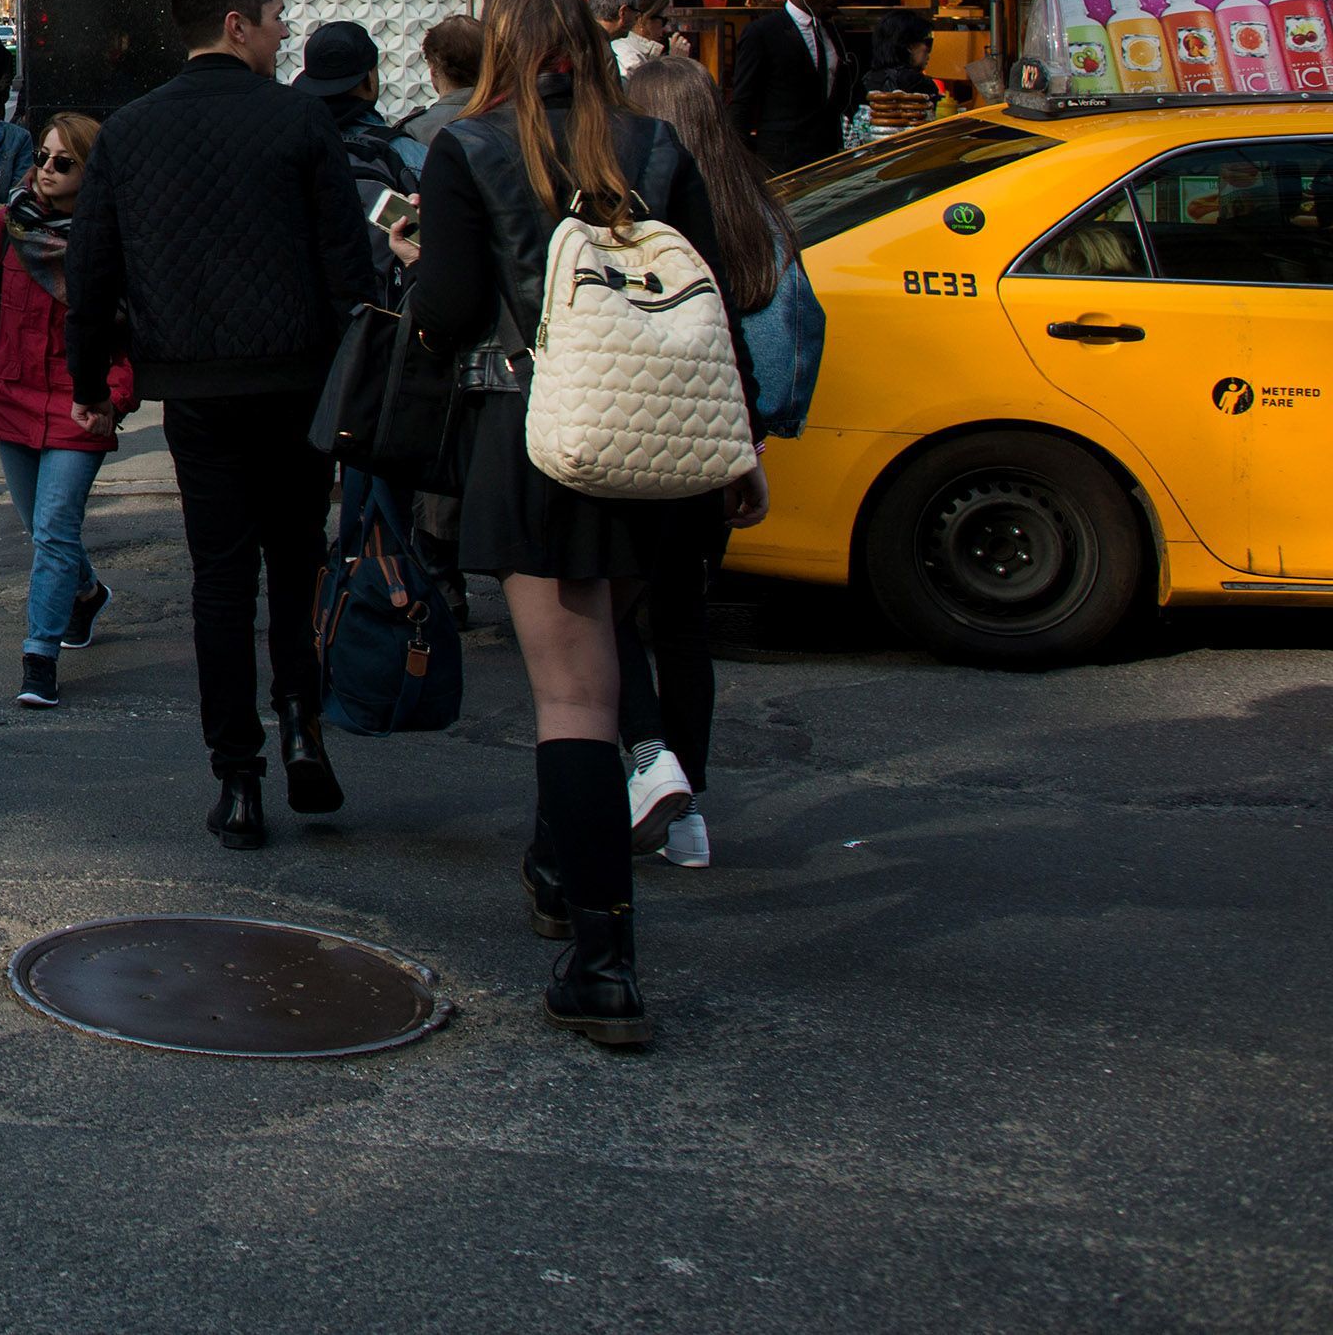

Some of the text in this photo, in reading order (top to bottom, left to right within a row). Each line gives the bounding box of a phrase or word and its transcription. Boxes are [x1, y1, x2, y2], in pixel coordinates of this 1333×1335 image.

[1239, 71, 1283, 92] ICE
[1293, 66, 1333, 89] ICE
[1078, 98, 1107, 107] VeriFone
[903, 270, 978, 297] 8C33
[1261, 386, 1321, 398] METERED
[1261, 397, 1294, 408] FARE
